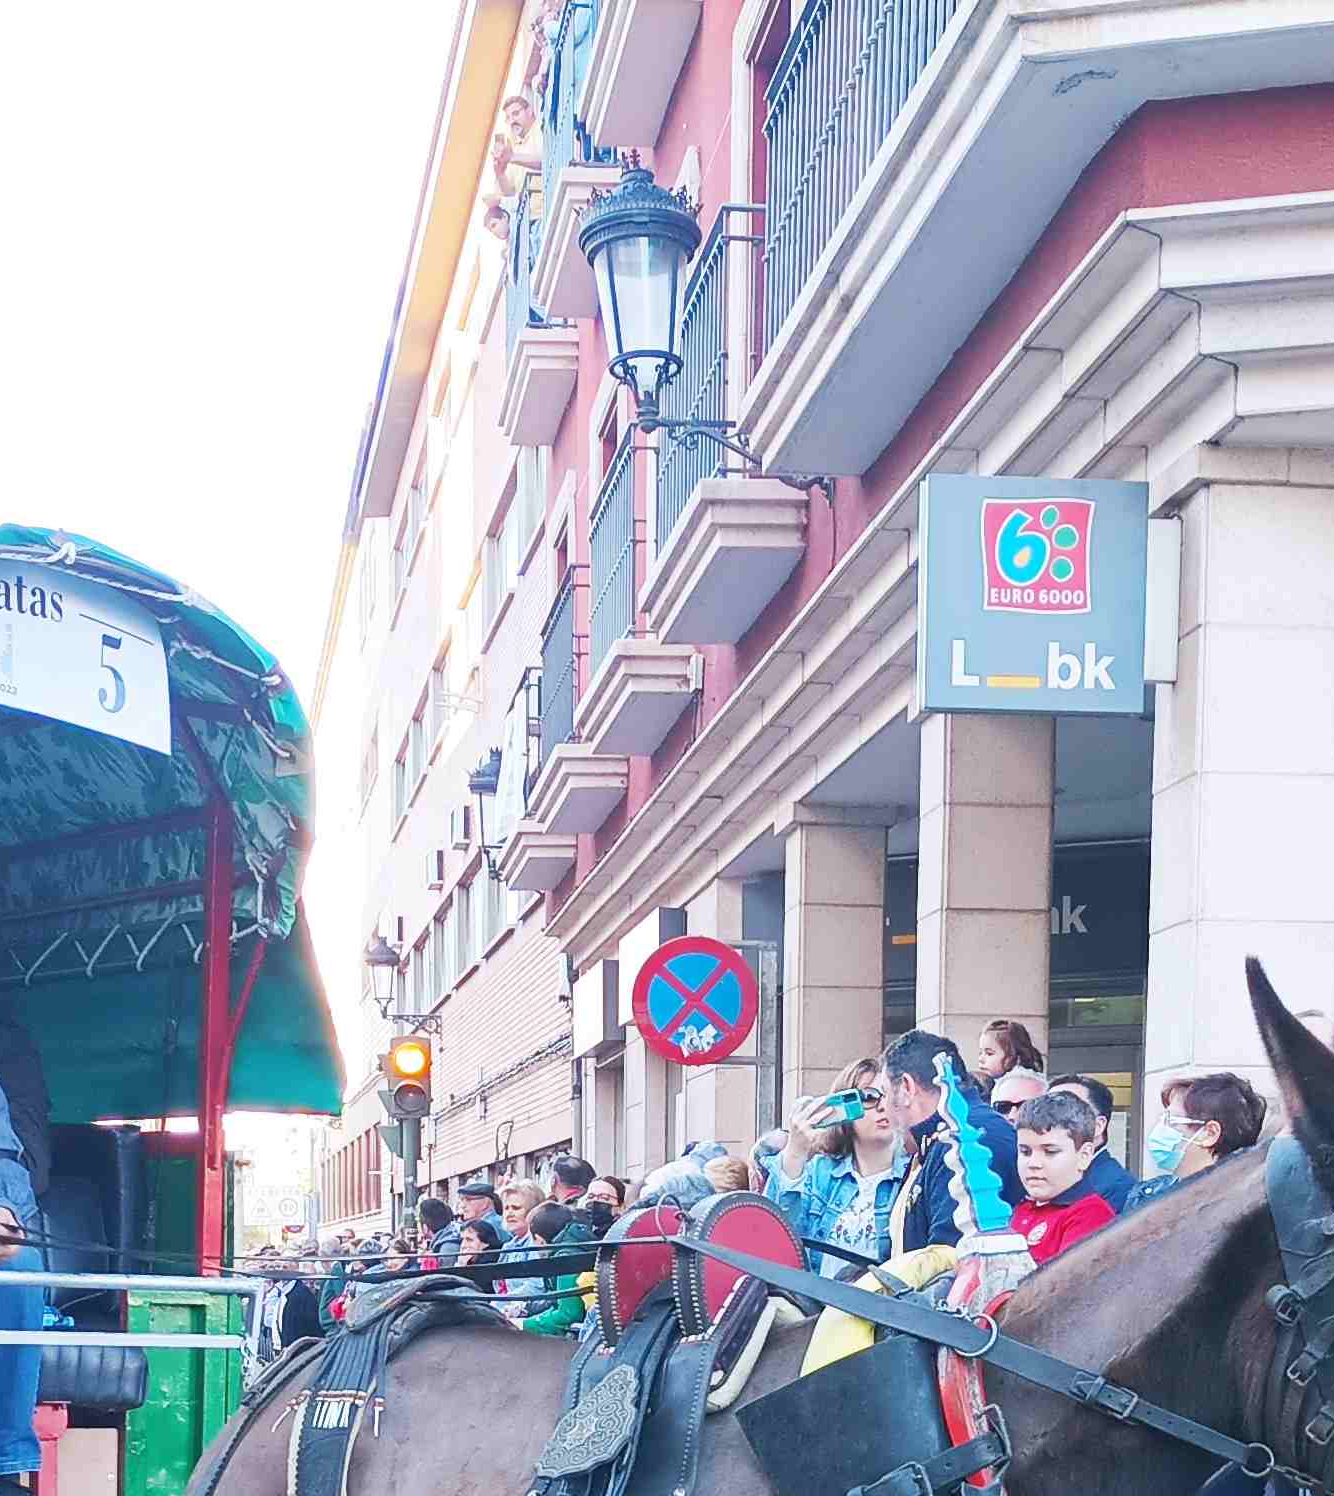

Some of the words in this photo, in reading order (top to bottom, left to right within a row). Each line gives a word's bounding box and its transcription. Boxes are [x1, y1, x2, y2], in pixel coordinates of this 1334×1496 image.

[990, 587, 1035, 604] EURO
[1038, 588, 1085, 605] 6000
[97, 633, 126, 714] 5
